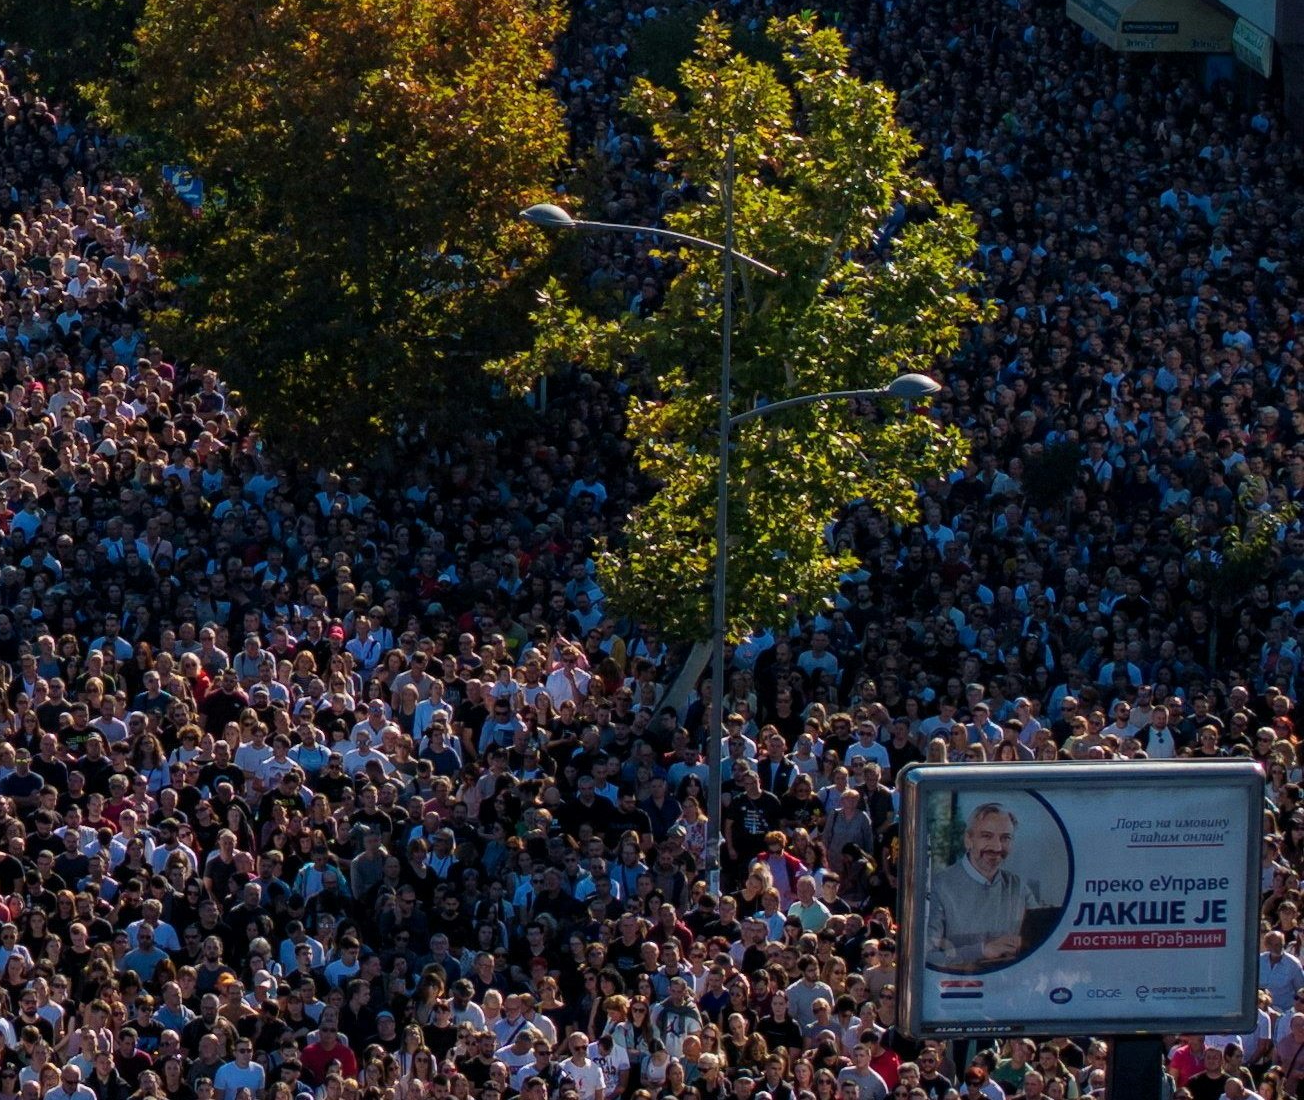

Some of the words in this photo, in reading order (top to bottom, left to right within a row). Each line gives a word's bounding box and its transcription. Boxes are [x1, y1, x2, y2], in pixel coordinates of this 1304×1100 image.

[1156, 820, 1172, 829] на
[1175, 818, 1230, 830] имовину
[1085, 879, 1143, 896] преко
[1149, 875, 1229, 895] еУправе
[1073, 901, 1186, 927] ЛАКШЕ
[1193, 900, 1227, 923] ЈЕ
[1073, 934, 1136, 947] постани
[1142, 932, 1222, 947] еГрађанин
